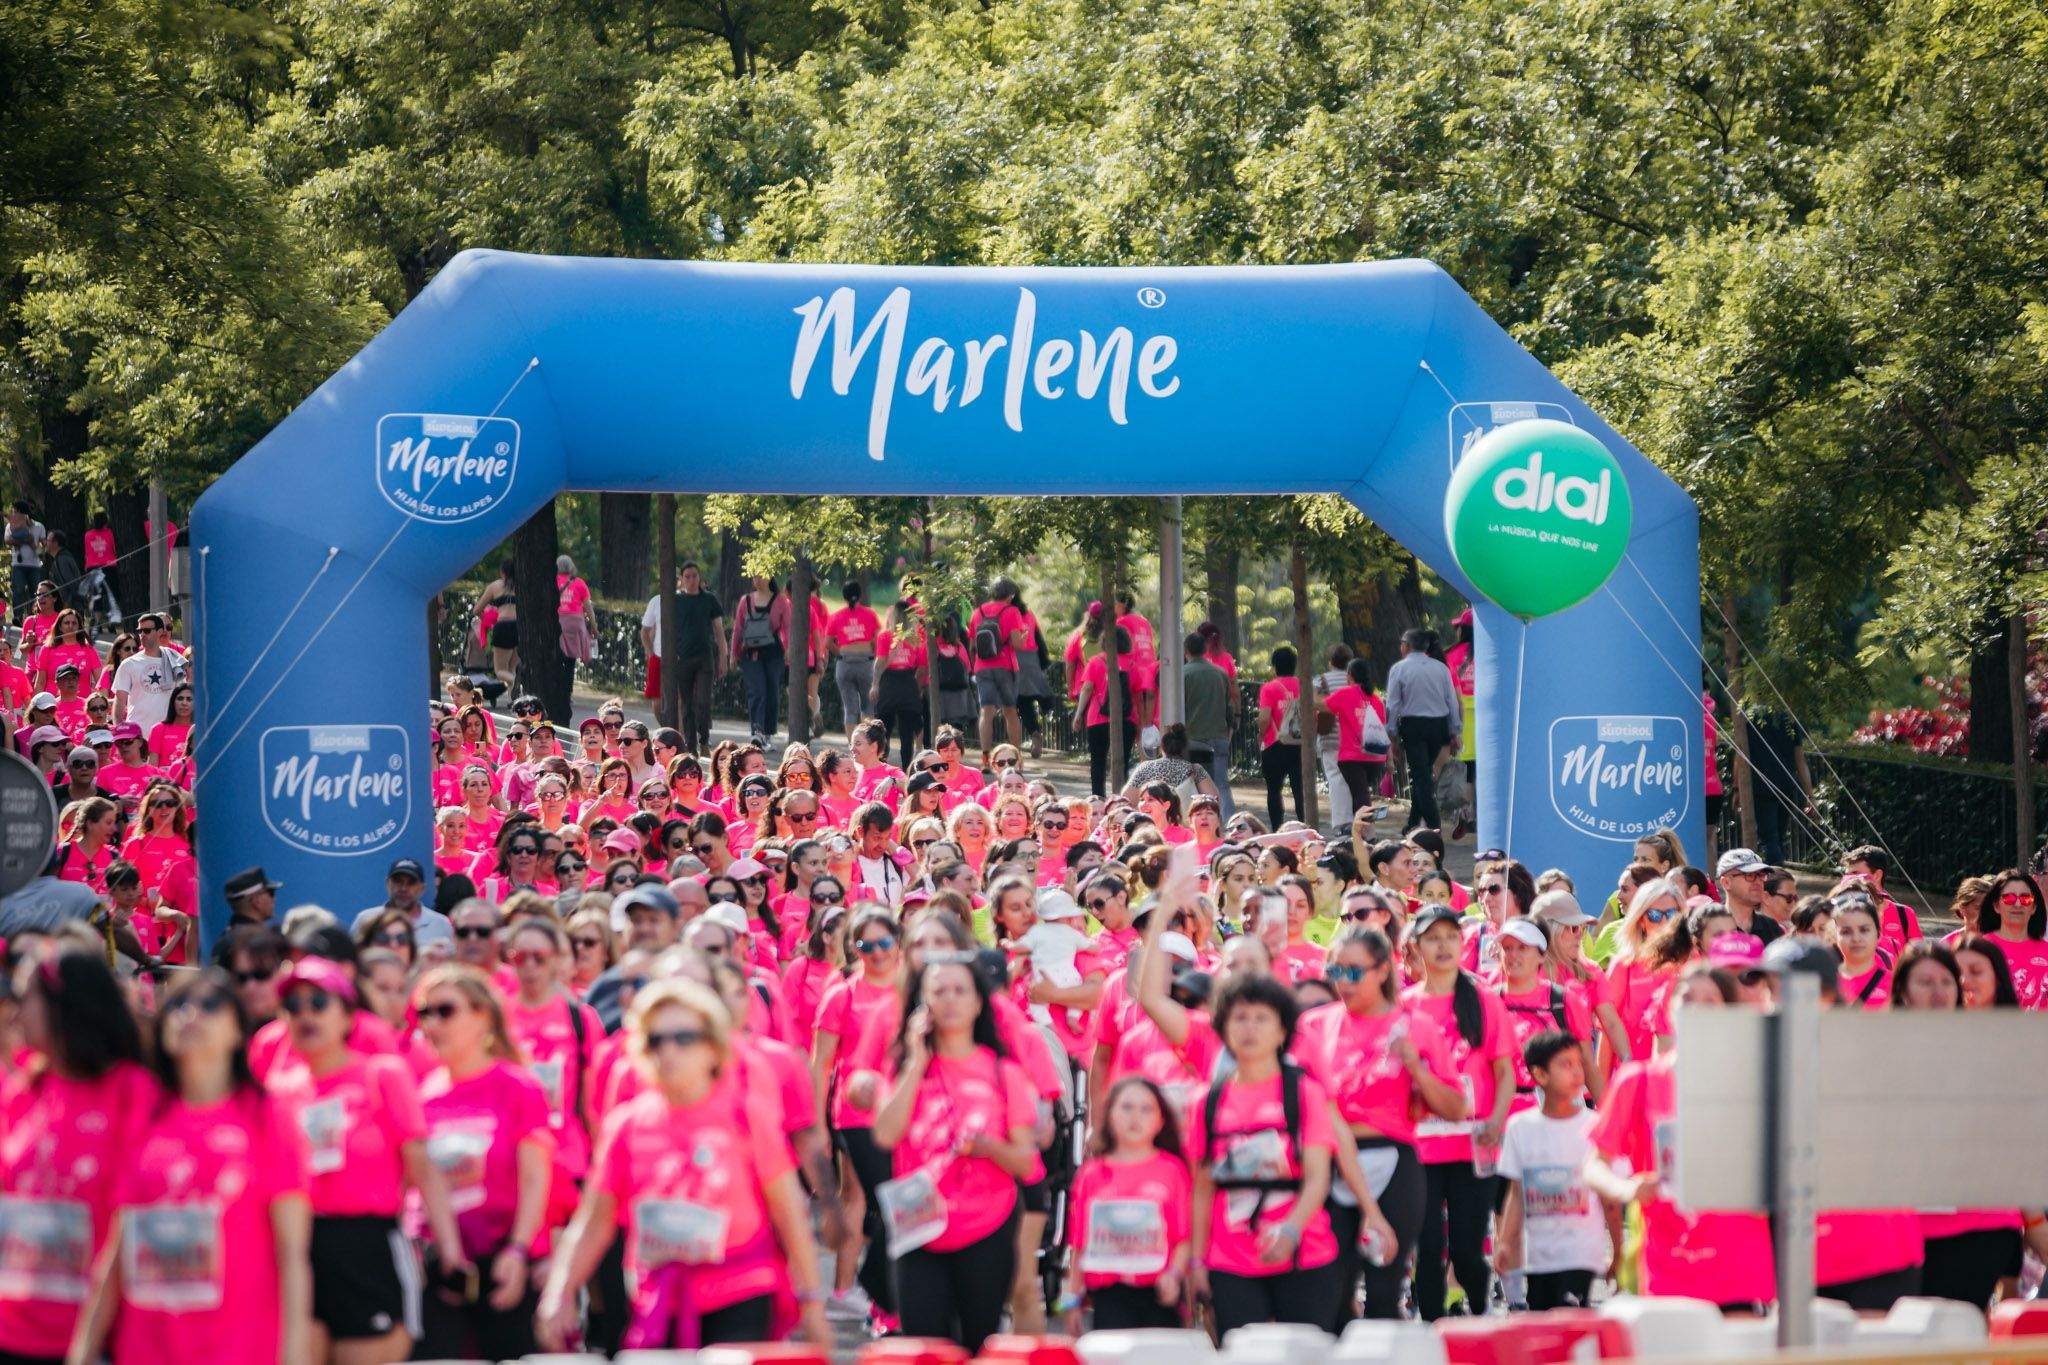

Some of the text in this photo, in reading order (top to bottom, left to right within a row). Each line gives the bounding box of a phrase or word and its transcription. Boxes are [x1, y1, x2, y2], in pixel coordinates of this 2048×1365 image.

[394, 488, 493, 516] HIJA DE LOS ALPES
[1492, 451, 1611, 526] dial
[1488, 524, 1499, 532] LA
[1539, 531, 1560, 543] QUE
[1561, 536, 1581, 548] NOS
[281, 818, 397, 847] HIJA DE LOS ALPES
[1570, 805, 1677, 833] HIJA DE LOS ALPES
